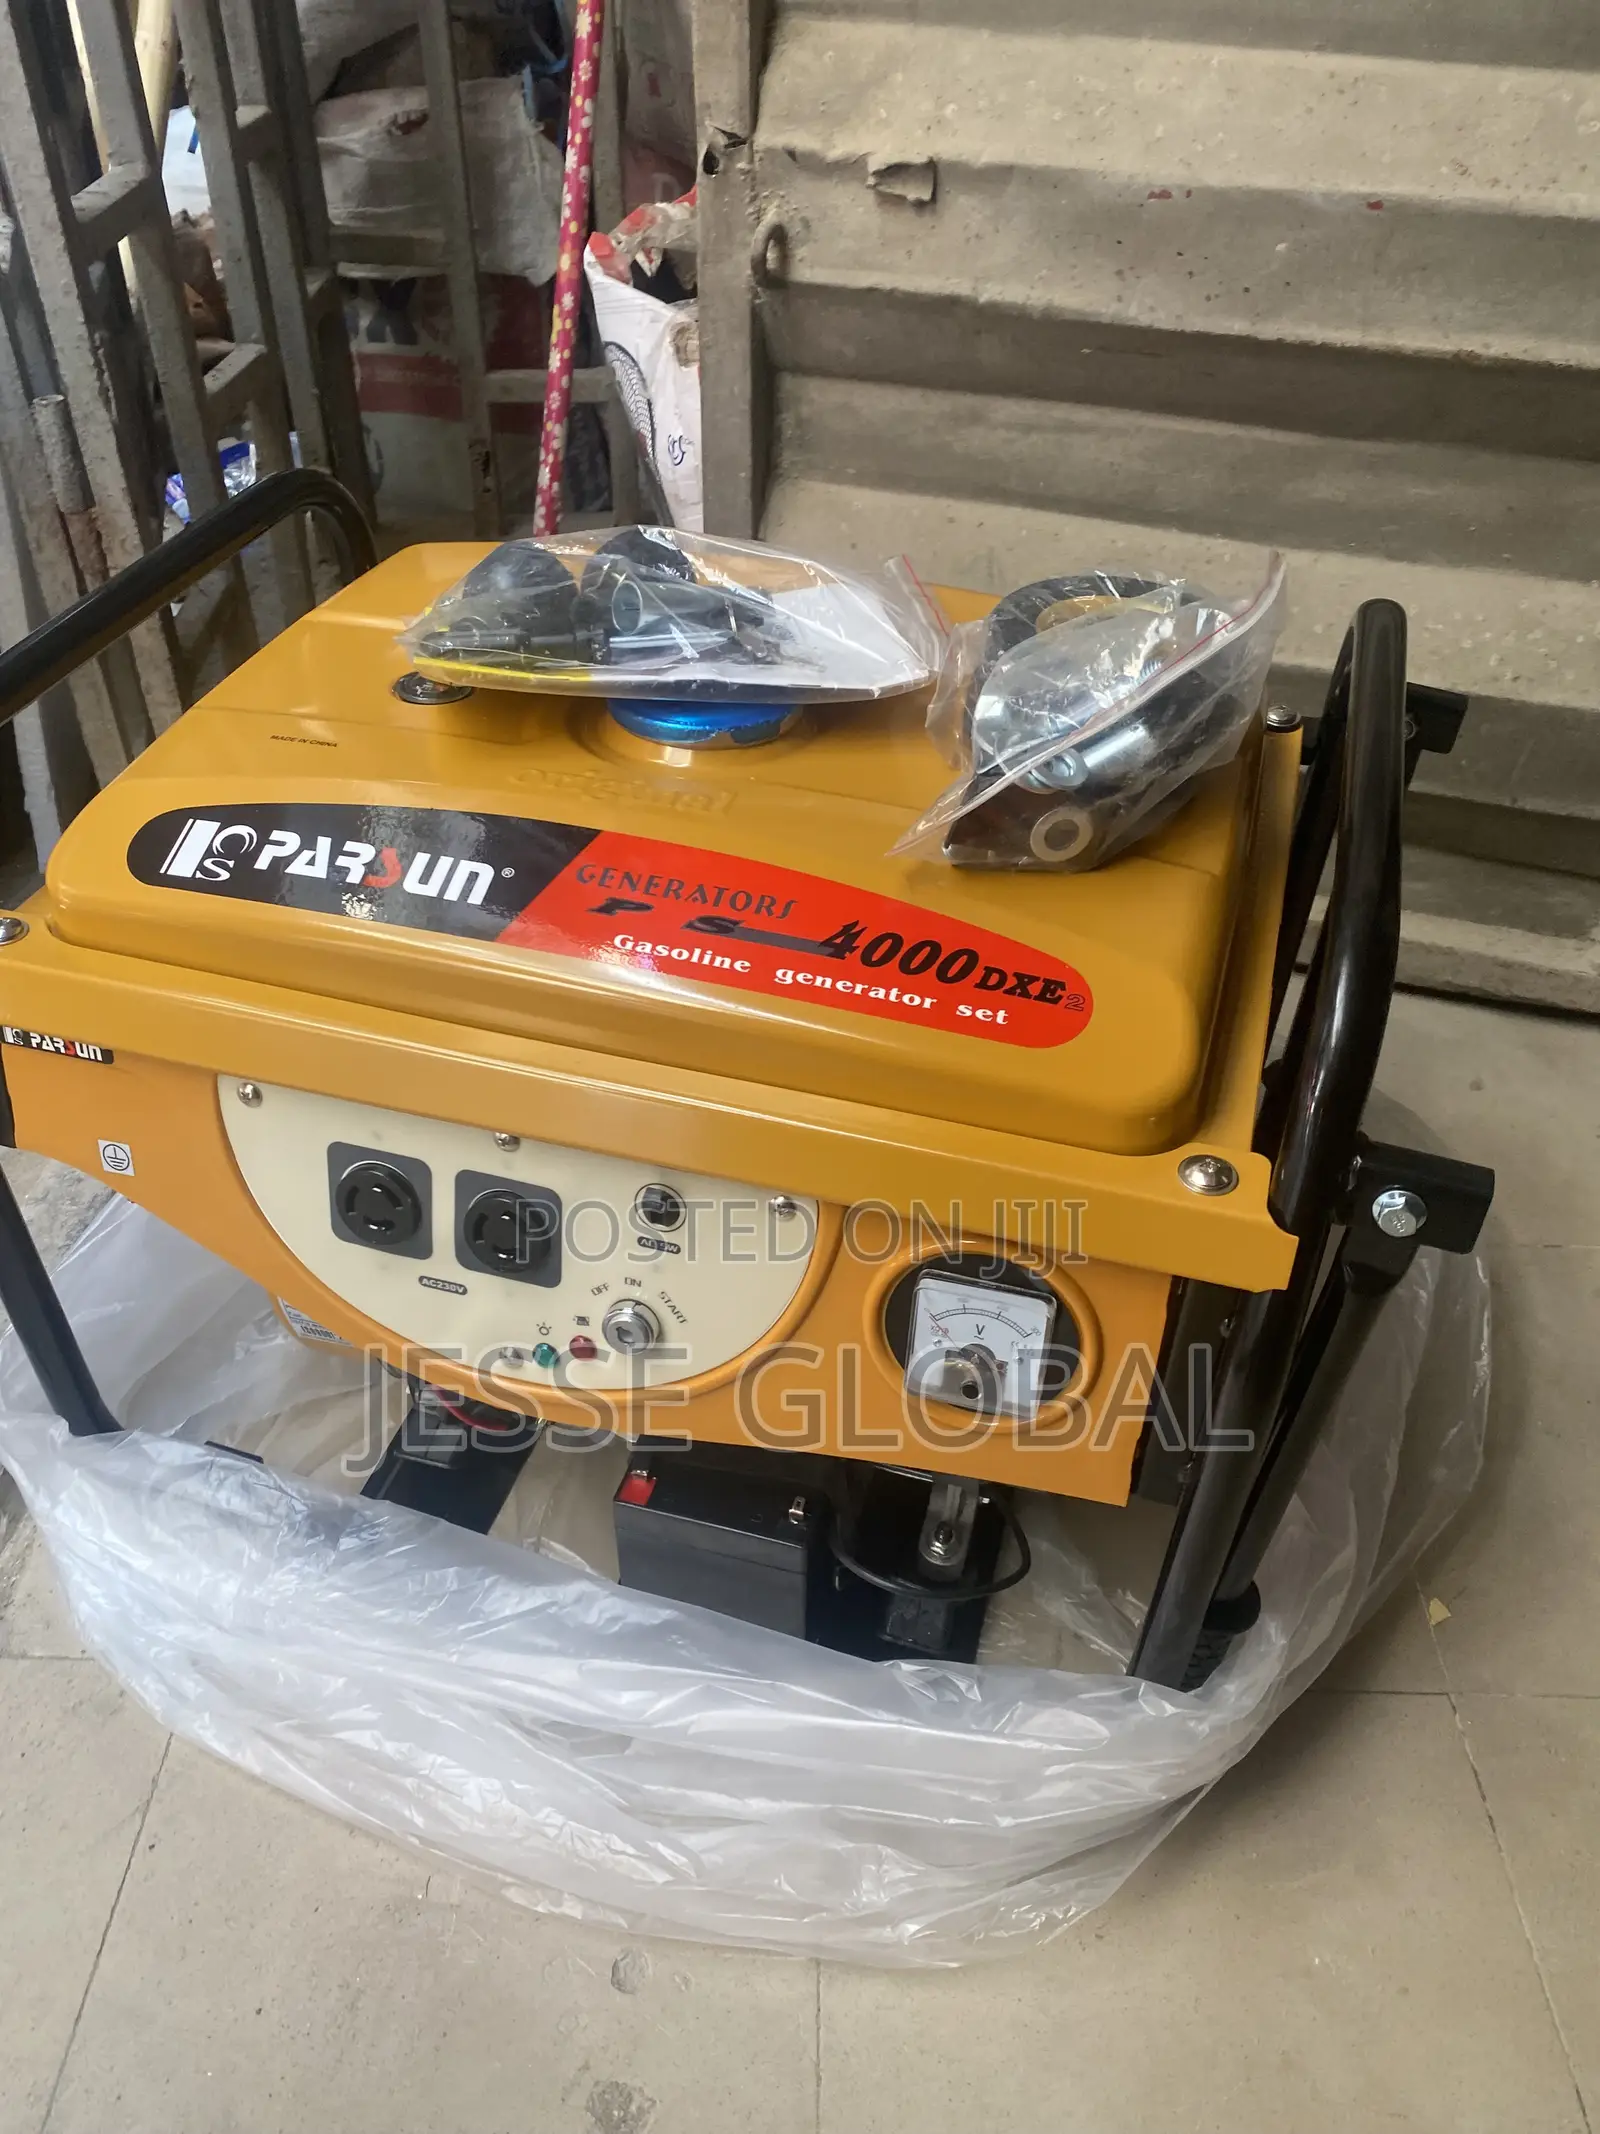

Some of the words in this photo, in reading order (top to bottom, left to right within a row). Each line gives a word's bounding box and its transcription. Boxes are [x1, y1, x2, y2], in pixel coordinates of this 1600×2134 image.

[253, 829, 495, 906] PARSUN
[575, 863, 799, 921] GENERATORS
[612, 932, 752, 974] Gasoline
[773, 965, 938, 1010] generator
[955, 1000, 1010, 1026] set
[29, 1032, 103, 1061] PARSUN
[421, 1278, 465, 1294] AC230V
[591, 1282, 610, 1296] OFF
[624, 1276, 642, 1288] ON
[659, 1291, 688, 1324] START
